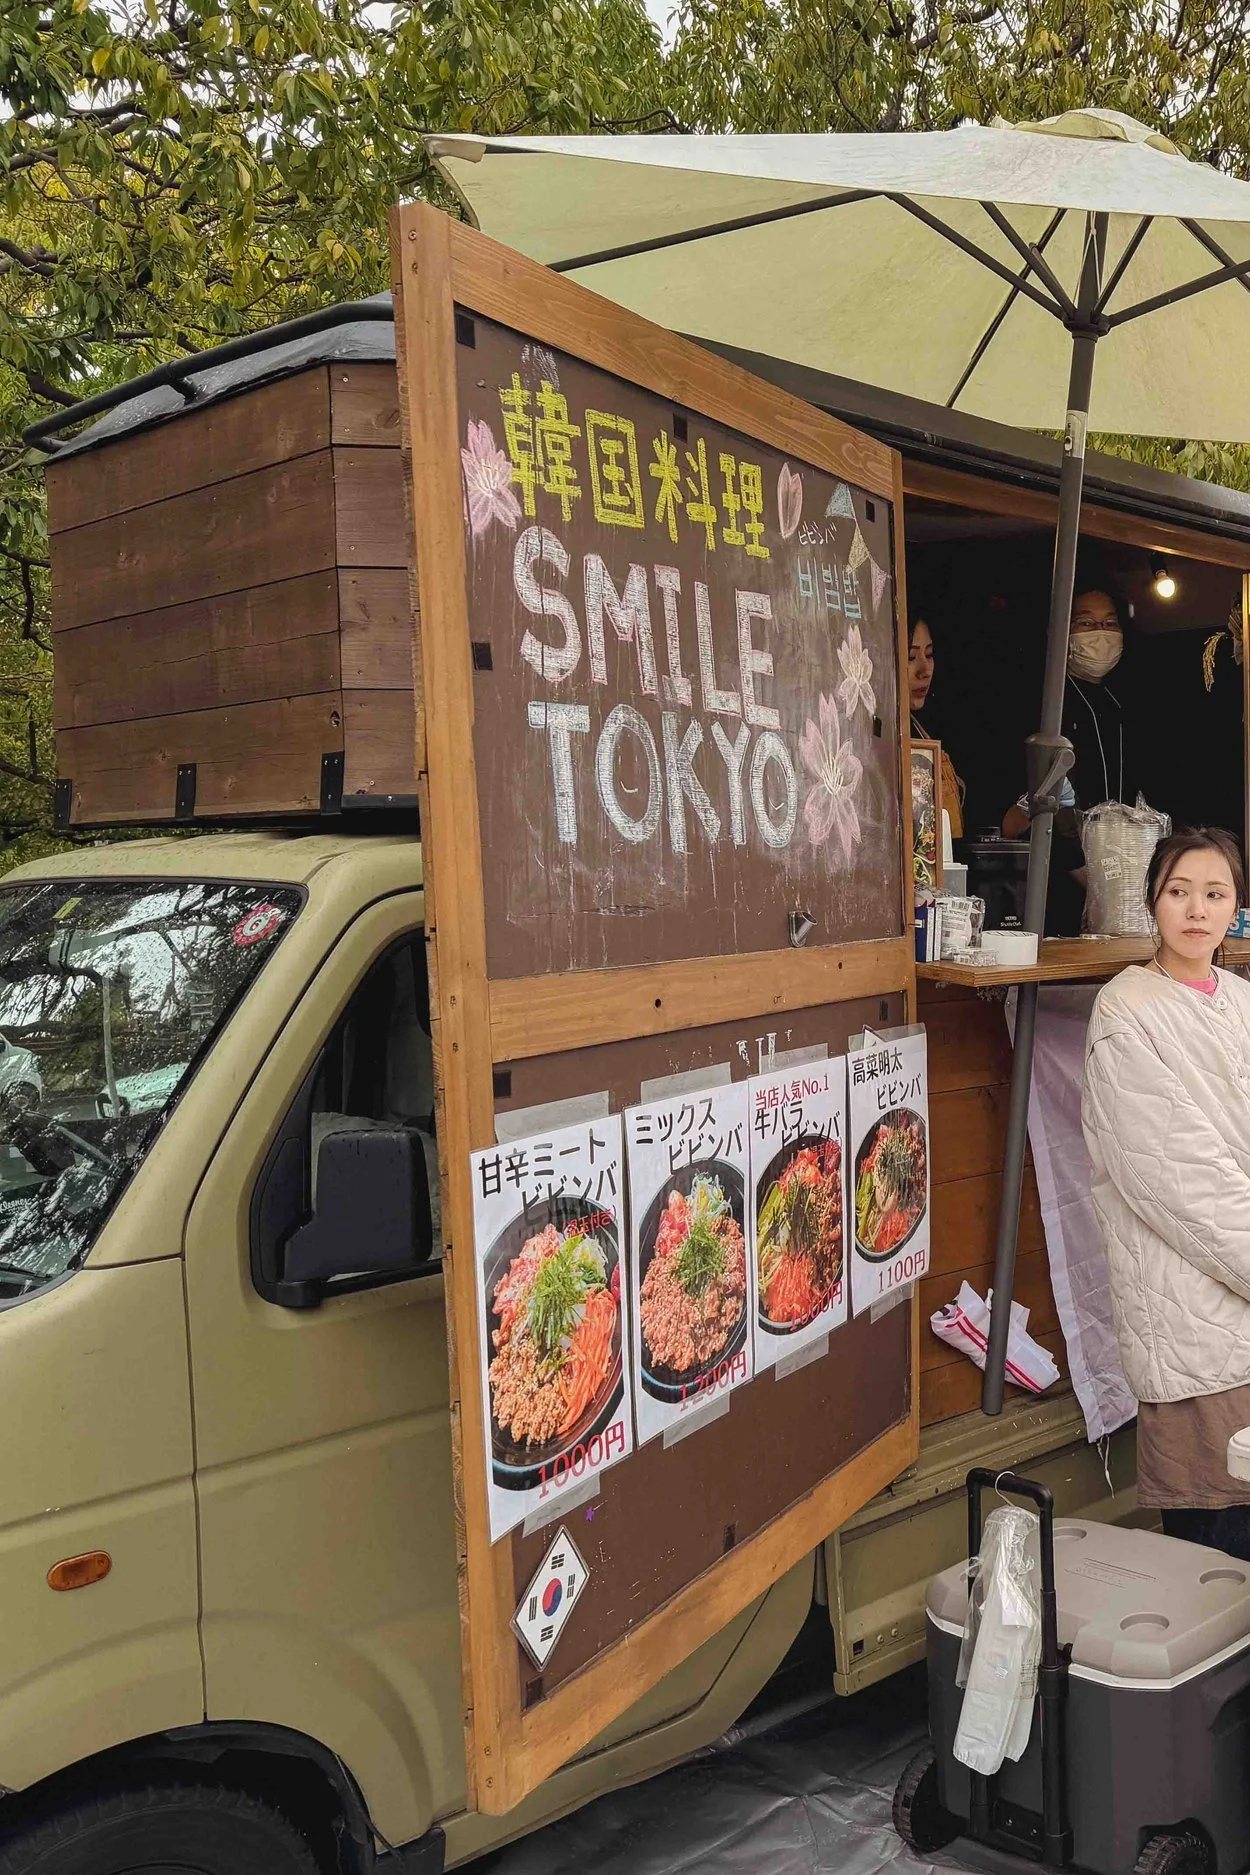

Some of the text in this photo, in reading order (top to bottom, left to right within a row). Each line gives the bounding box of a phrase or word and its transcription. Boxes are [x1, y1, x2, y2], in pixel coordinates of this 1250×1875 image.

[499, 371, 771, 559] 韓国料理
[513, 525, 782, 730] SMILE
[526, 700, 798, 854] TOKYO
[851, 1047, 903, 1086] 高菜明太
[876, 1073, 922, 1110] ビビンバ
[635, 1097, 716, 1145] ミックス
[668, 1122, 743, 1175] ビビンバ
[754, 1100, 803, 1140] 牛バラ
[478, 1128, 605, 1198] 甘辛ミート
[521, 1160, 617, 1226] ビビンバ
[877, 1249, 926, 1293] 1100円
[679, 1351, 747, 1412] 1200円
[538, 1420, 625, 1499] 1000円
